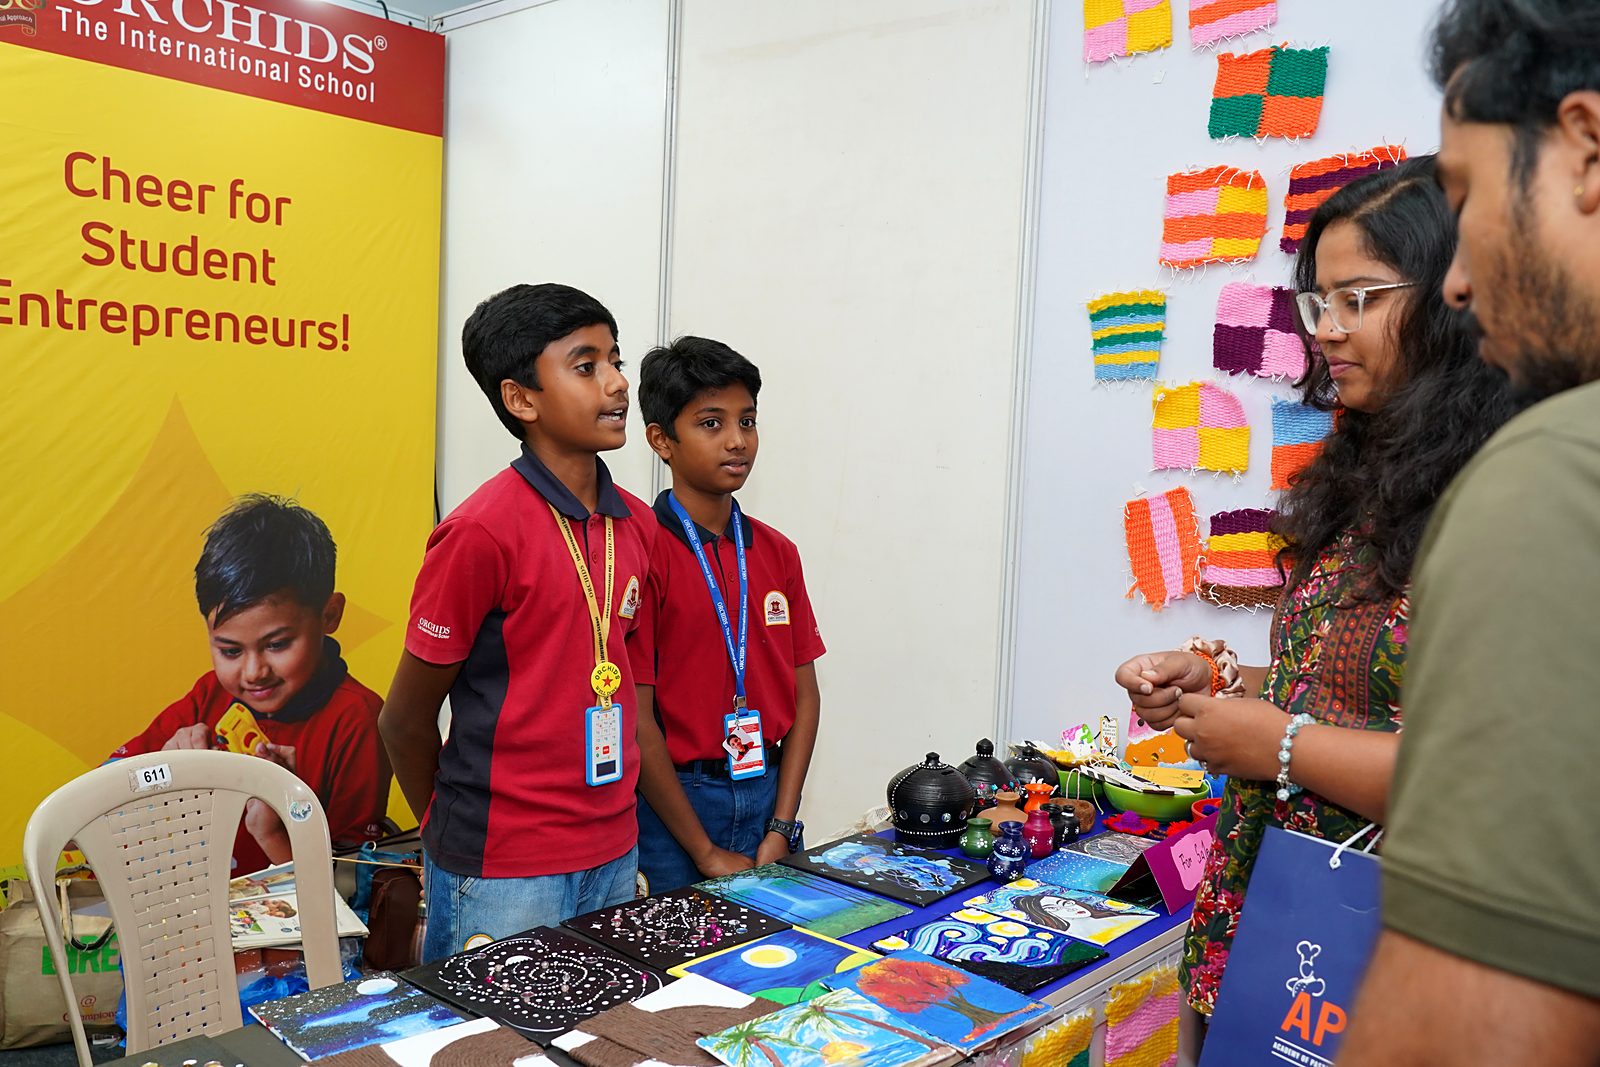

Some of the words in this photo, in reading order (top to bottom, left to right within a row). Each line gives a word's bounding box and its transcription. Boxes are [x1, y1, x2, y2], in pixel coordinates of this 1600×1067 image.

[56, 6, 107, 41] The
[120, 21, 289, 83] International
[298, 65, 375, 103] School
[64, 151, 215, 215] Cheer
[229, 179, 291, 226] for
[81, 221, 276, 286] Student
[144, 768, 165, 783] 611
[1272, 1041, 1300, 1060] ACADEMY
[1300, 1054, 1310, 1064] OF
